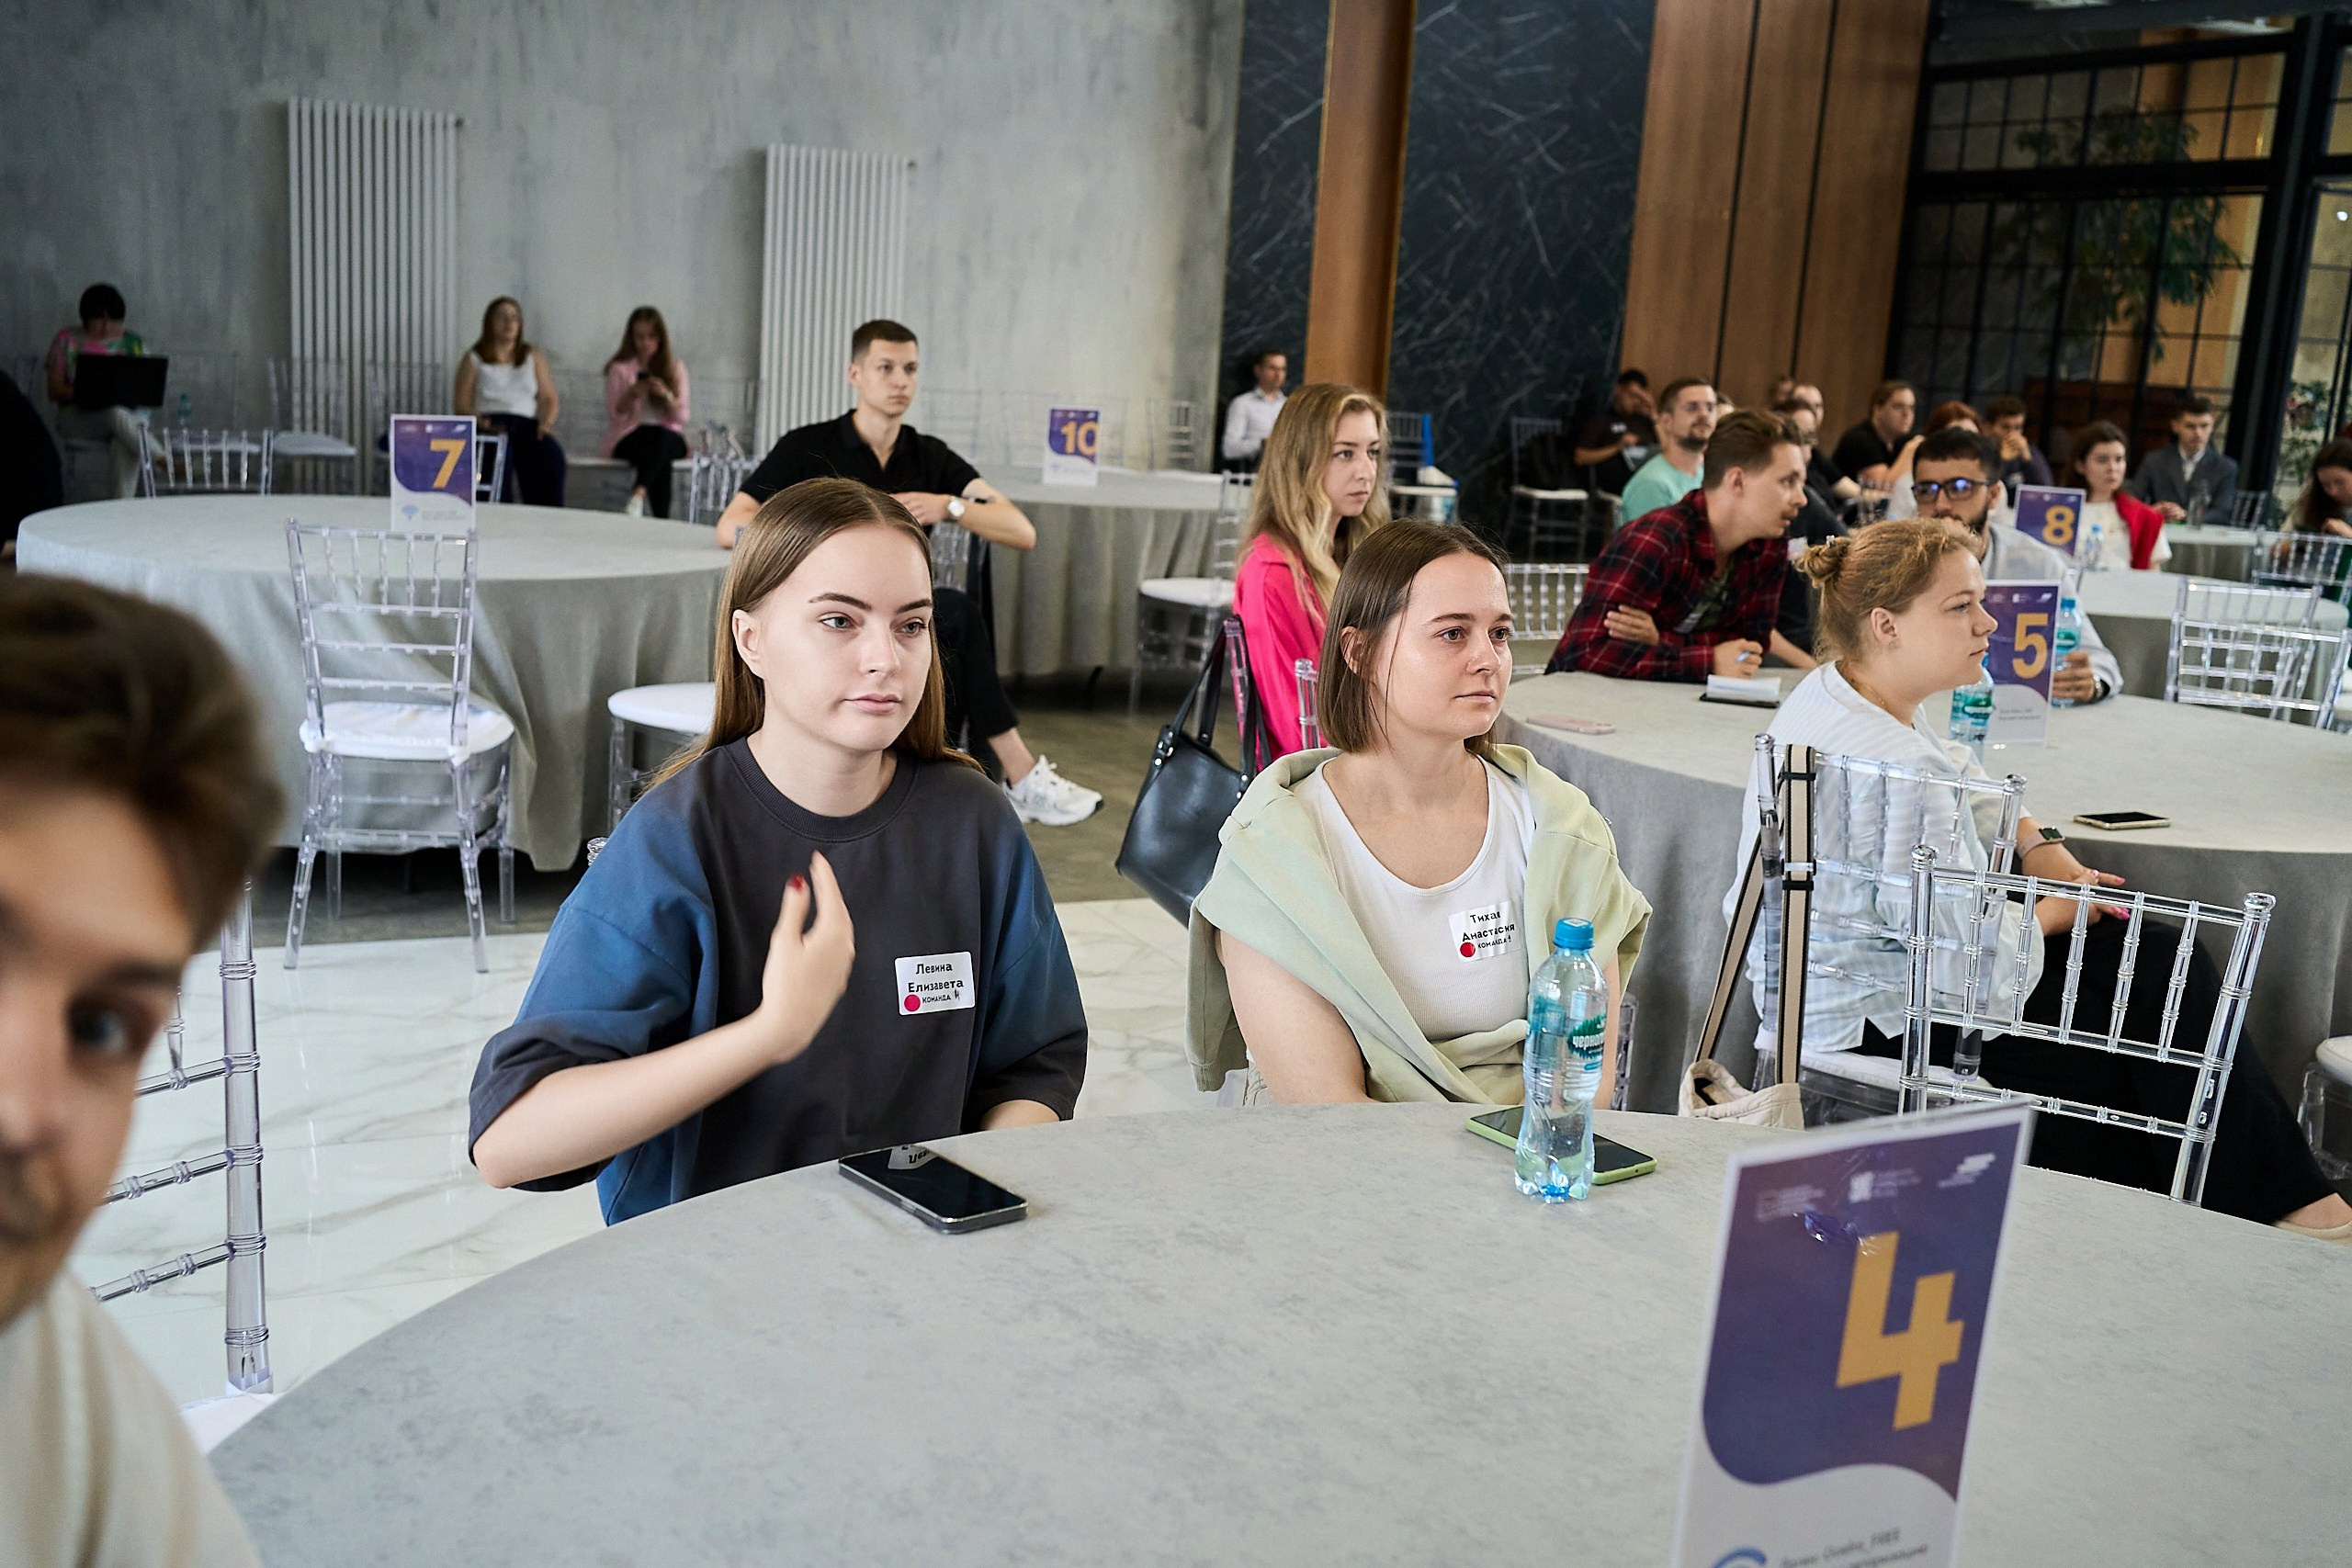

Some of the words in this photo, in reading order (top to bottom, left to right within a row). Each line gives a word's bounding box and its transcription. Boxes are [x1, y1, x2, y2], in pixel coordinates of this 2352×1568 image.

[1061, 421, 1099, 455] 10
[430, 438, 467, 490] 7
[2042, 505, 2075, 546] 8
[2012, 613, 2049, 680] 5
[908, 980, 964, 993] Елизавета
[916, 964, 953, 975] Левина
[1836, 1231, 1965, 1431] 4
